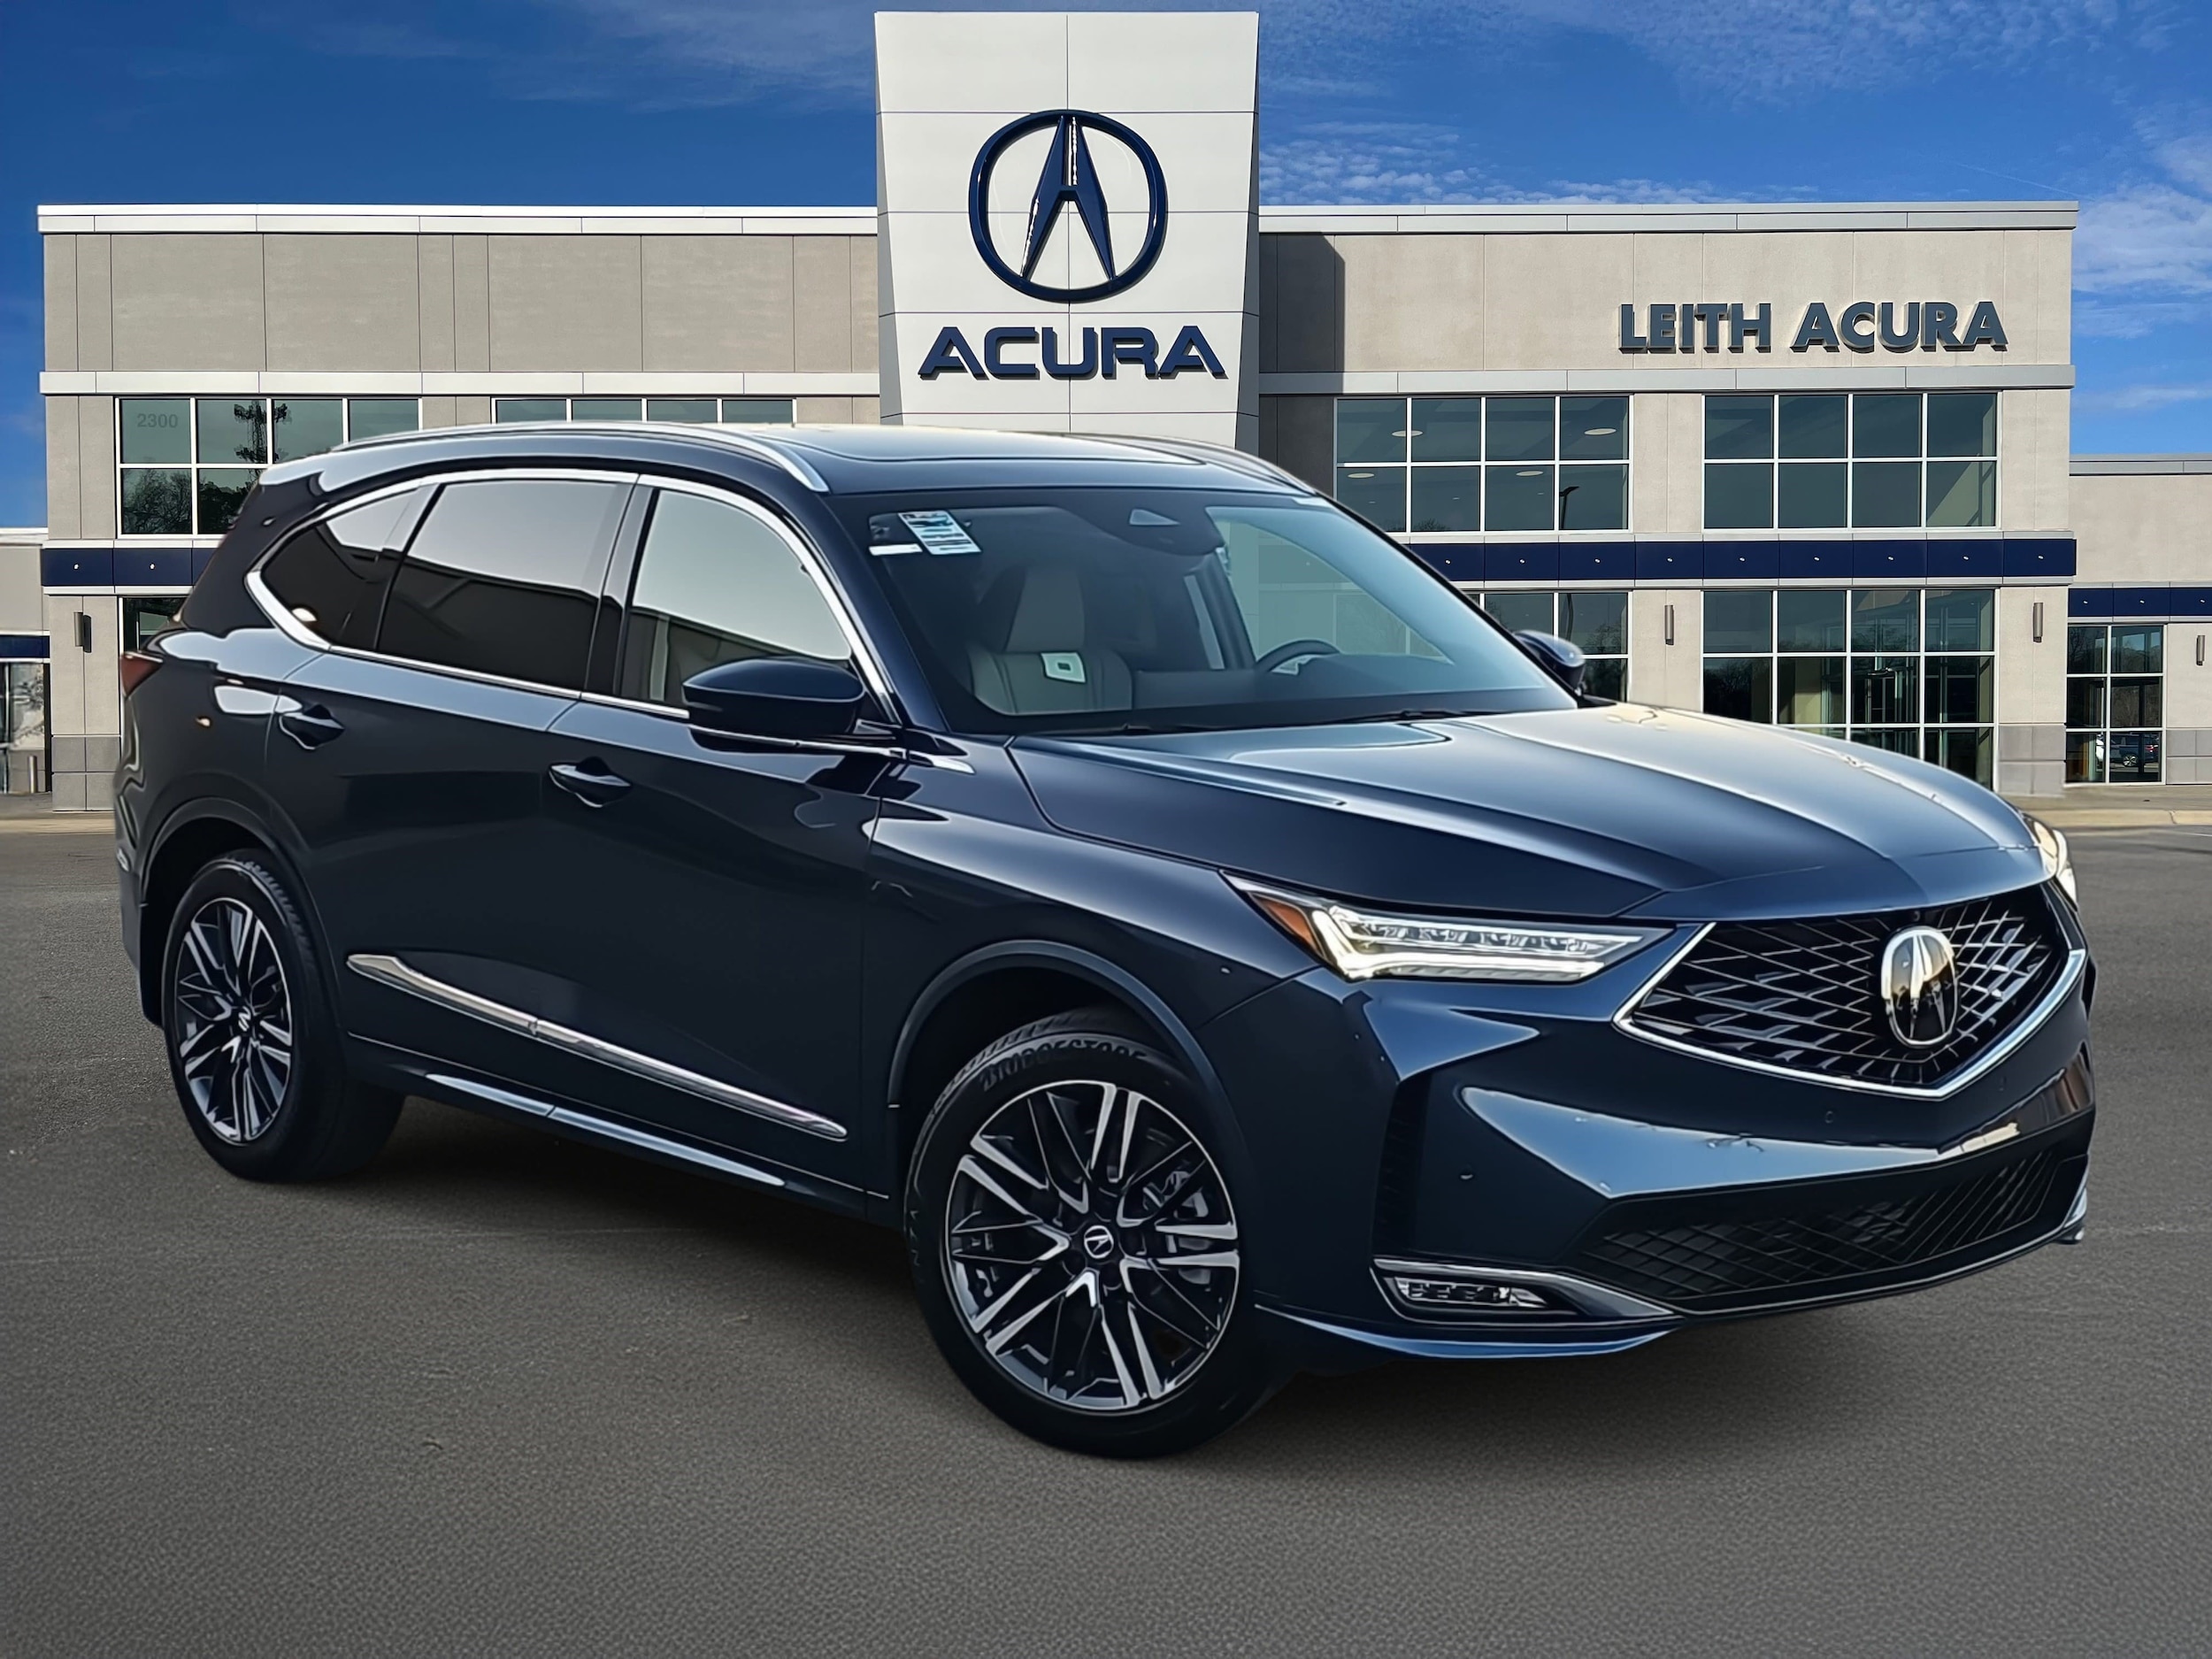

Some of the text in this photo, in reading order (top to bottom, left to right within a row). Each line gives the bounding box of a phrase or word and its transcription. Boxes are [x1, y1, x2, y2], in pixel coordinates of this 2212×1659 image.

[918, 326, 1228, 380] ACURA
[1618, 301, 2008, 354] LEITH ACURA
[136, 413, 179, 428] 2300
